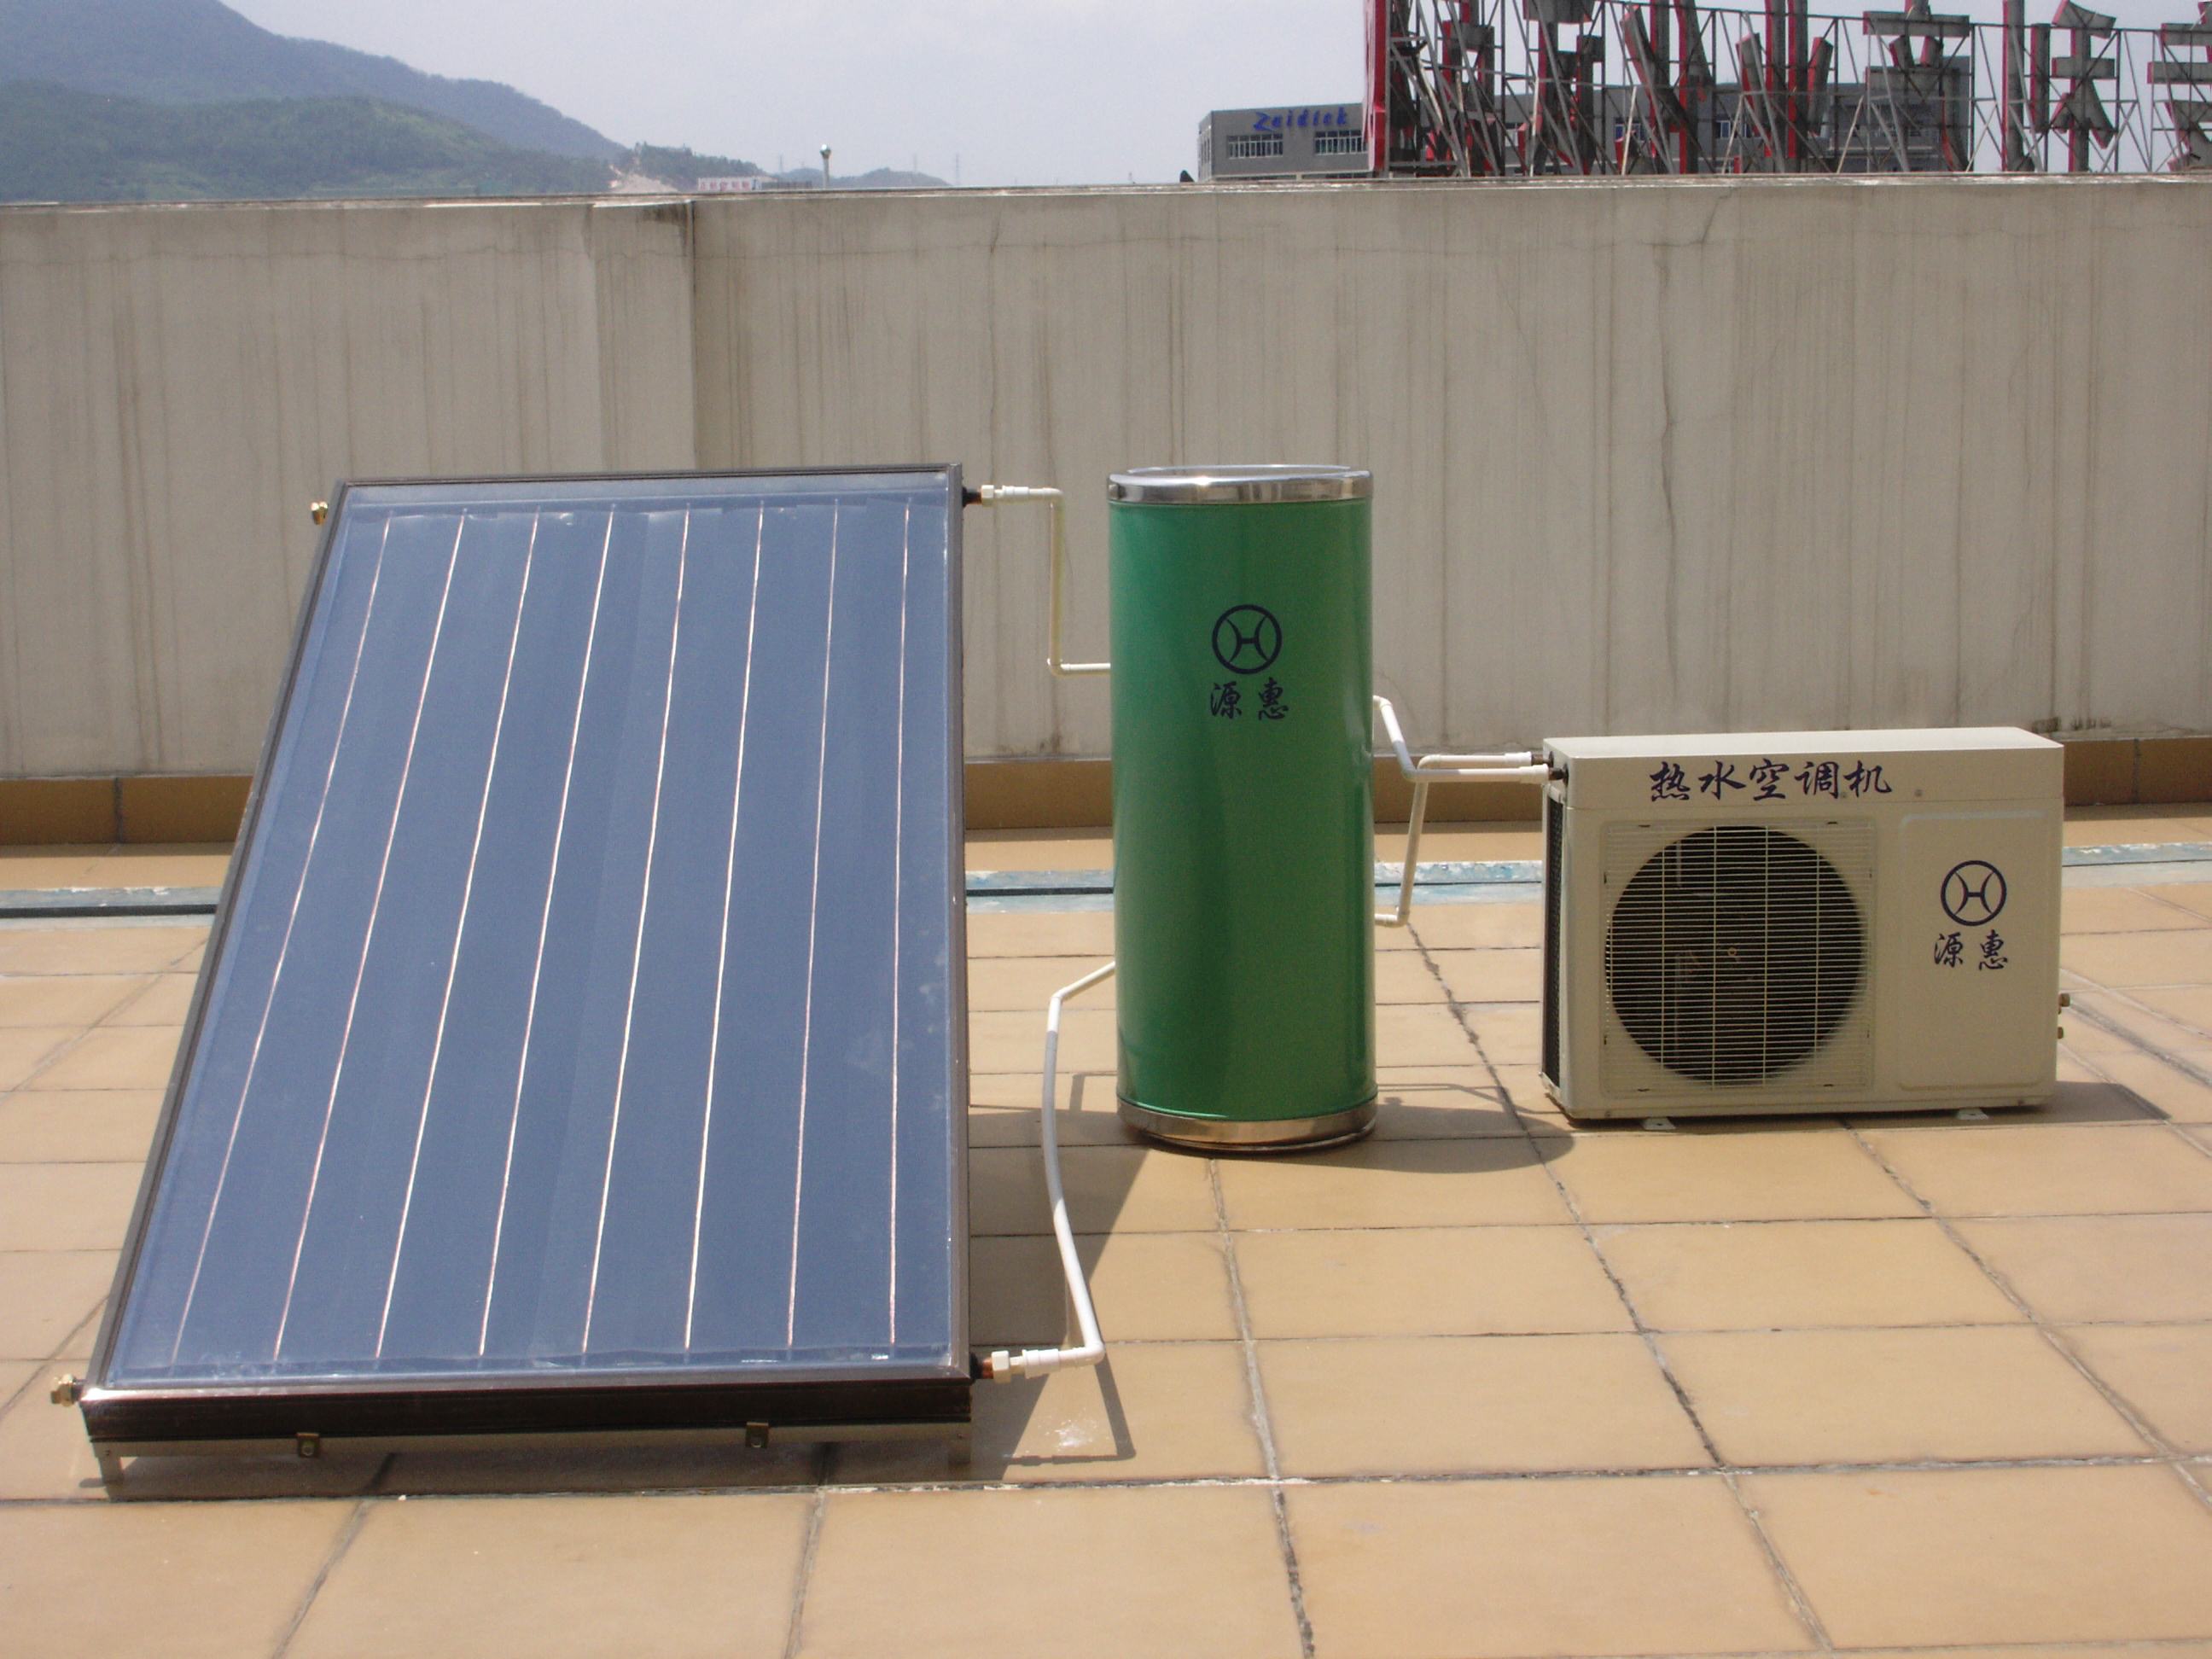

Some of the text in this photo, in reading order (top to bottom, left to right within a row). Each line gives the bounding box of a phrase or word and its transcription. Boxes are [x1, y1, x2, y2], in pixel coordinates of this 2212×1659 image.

[1210, 677, 1289, 721] 源惠
[1649, 758, 1893, 802] 热水空调机
[1933, 928, 2009, 971] 源惠
